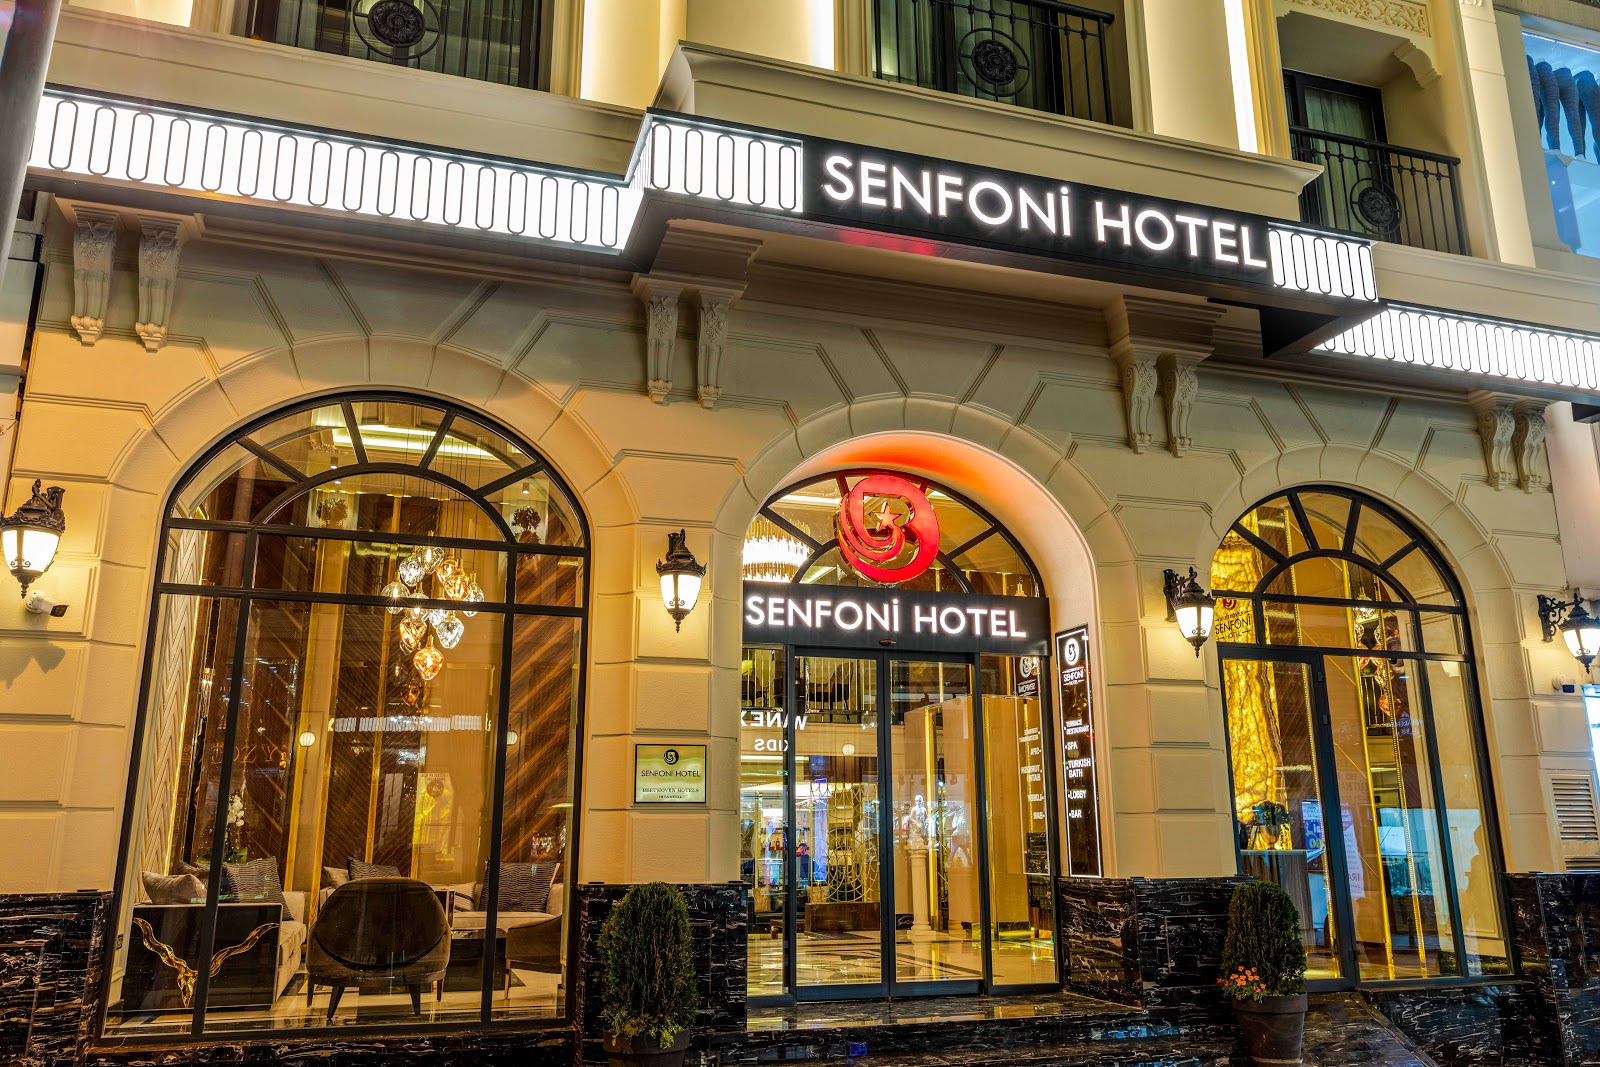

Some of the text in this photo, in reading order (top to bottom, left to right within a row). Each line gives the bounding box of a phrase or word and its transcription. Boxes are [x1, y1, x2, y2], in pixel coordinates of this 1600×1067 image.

[1095, 200, 1268, 269] HOTEL
[914, 605, 1026, 637] HOTEL
[1068, 758, 1091, 769] TURKISH
[1069, 769, 1083, 778] BATH
[1069, 790, 1087, 799] LOBBY
[1071, 810, 1082, 818] BAR
